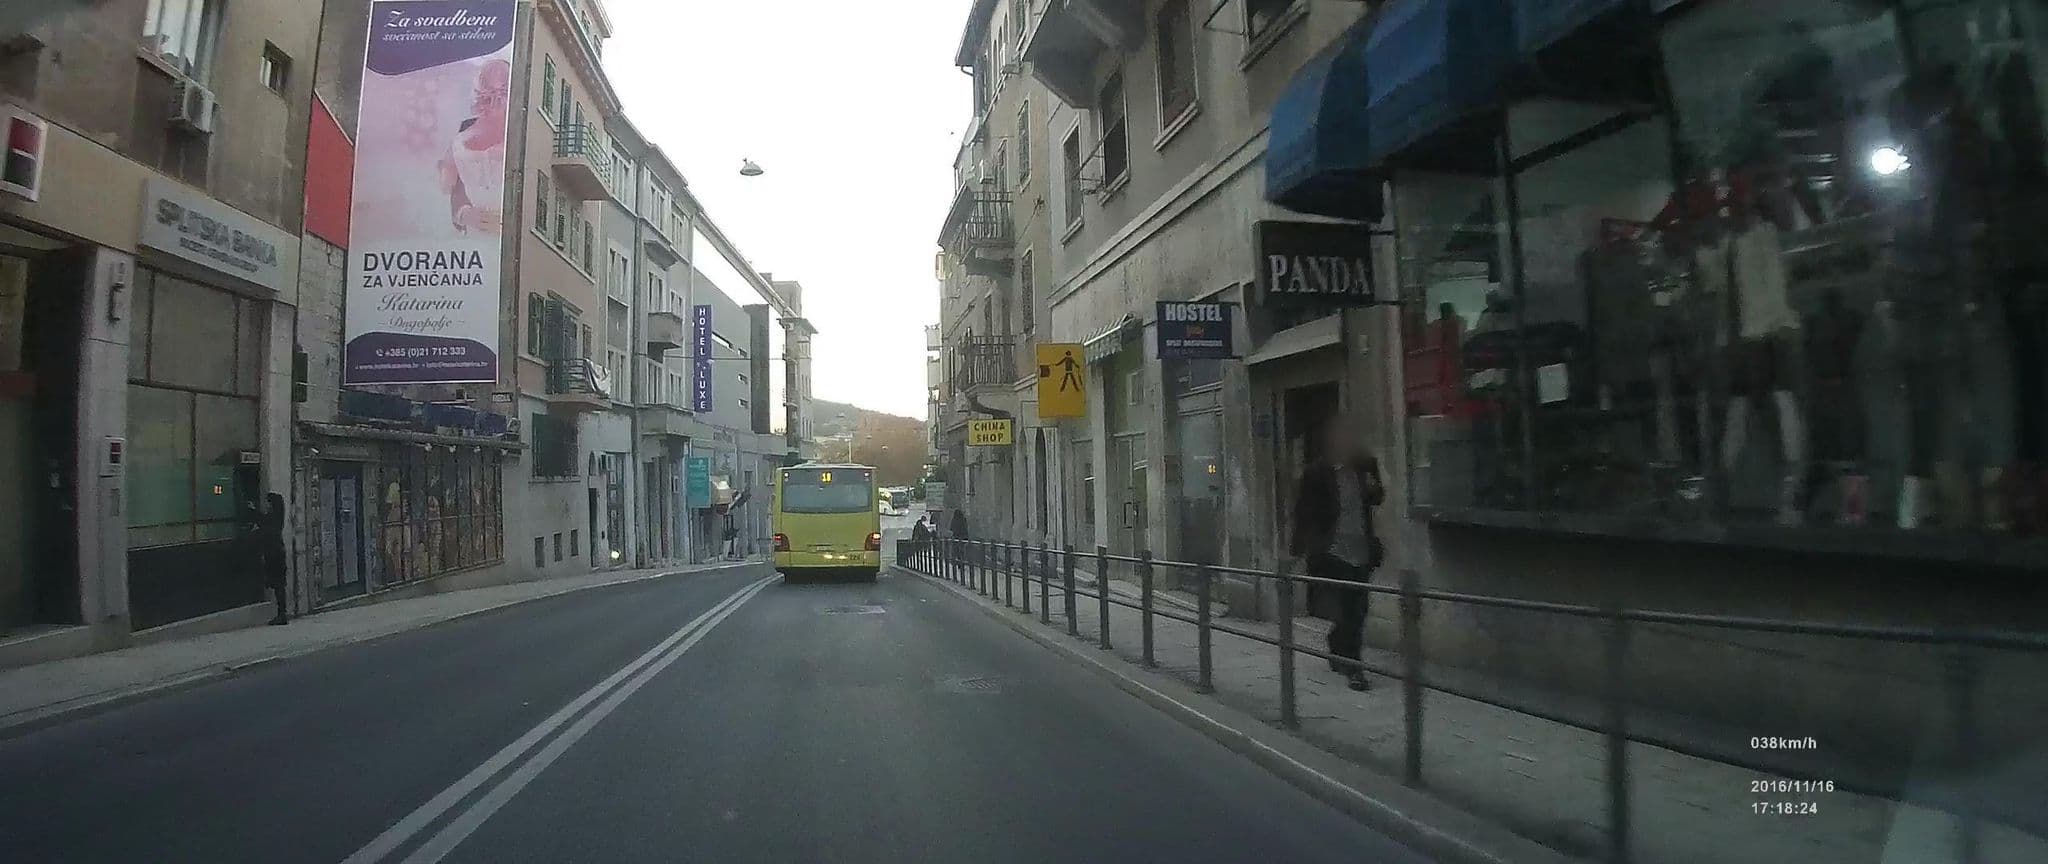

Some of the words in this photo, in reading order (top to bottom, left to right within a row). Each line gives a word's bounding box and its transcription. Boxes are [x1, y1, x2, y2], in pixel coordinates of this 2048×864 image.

[384, 9, 411, 27] Za
[414, 9, 498, 27] svadbenu
[459, 26, 496, 40] stilom
[363, 250, 484, 272] DVORANA
[363, 275, 384, 288] ZA
[388, 271, 483, 288] VJENČANJA
[1268, 254, 1371, 295] PANDA
[377, 292, 464, 312] Katarina
[1165, 303, 1223, 322] HOSTEL
[389, 315, 453, 332] Dugopolje
[385, 348, 406, 357] +385
[408, 347, 429, 358] (0)21
[432, 347, 448, 356] 712
[450, 346, 466, 356] 333
[974, 422, 1005, 432] CHINA
[977, 433, 1004, 443] SHOP
